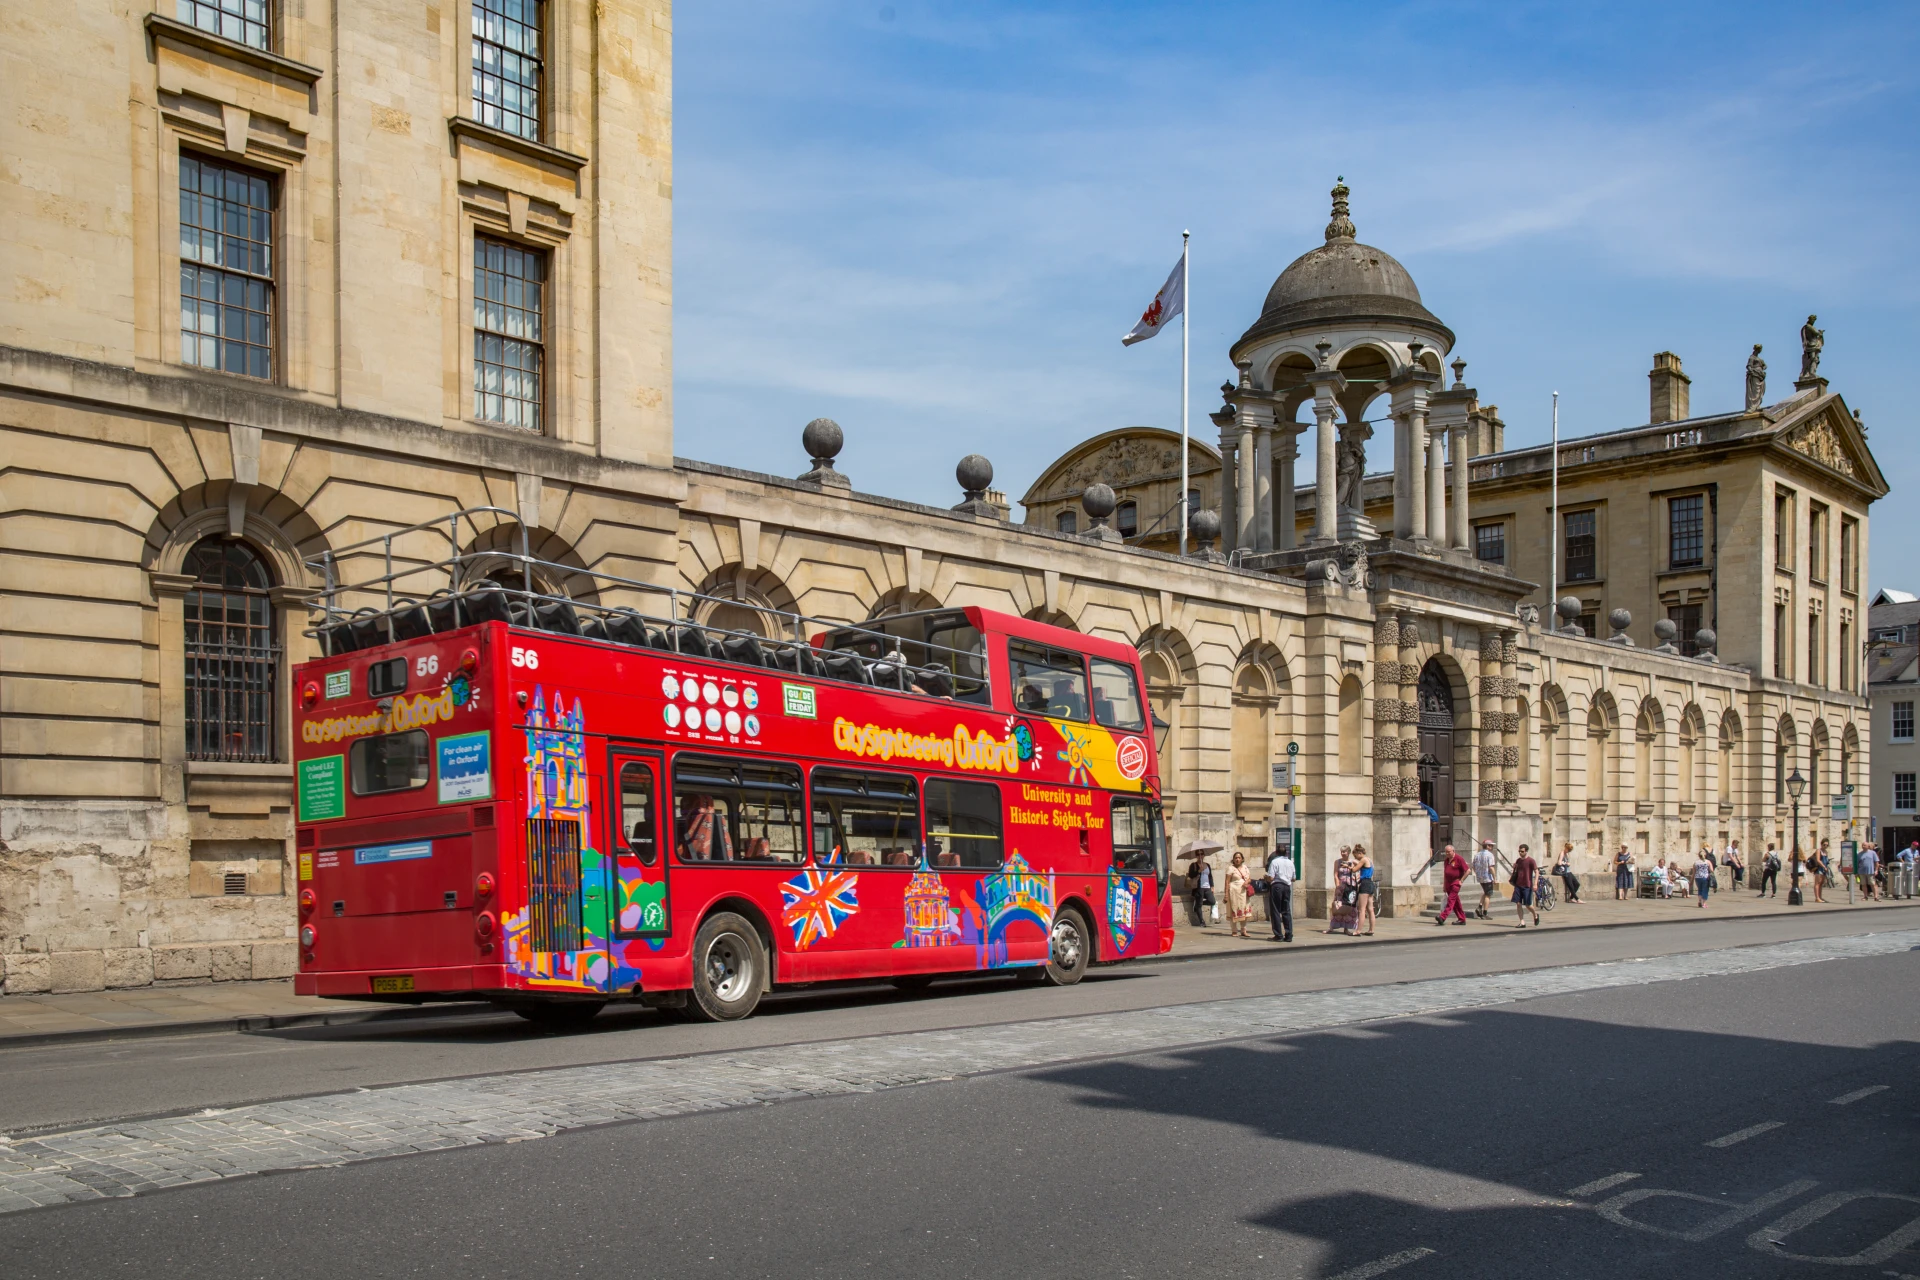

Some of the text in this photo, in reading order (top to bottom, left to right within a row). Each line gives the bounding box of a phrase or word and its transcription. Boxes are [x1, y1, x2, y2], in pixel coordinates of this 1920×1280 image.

[416, 655, 439, 677] 56
[511, 646, 540, 669] 56
[392, 685, 454, 731] Oxford
[788, 702, 812, 713] FRIDAY
[444, 742, 483, 756] For clean air
[833, 716, 1019, 773] CitySightseeing Oxford
[1287, 744, 1298, 753] K3
[456, 754, 479, 764] Oxford
[1021, 783, 1092, 807] University and
[1010, 806, 1104, 830] Historic Sights Tour
